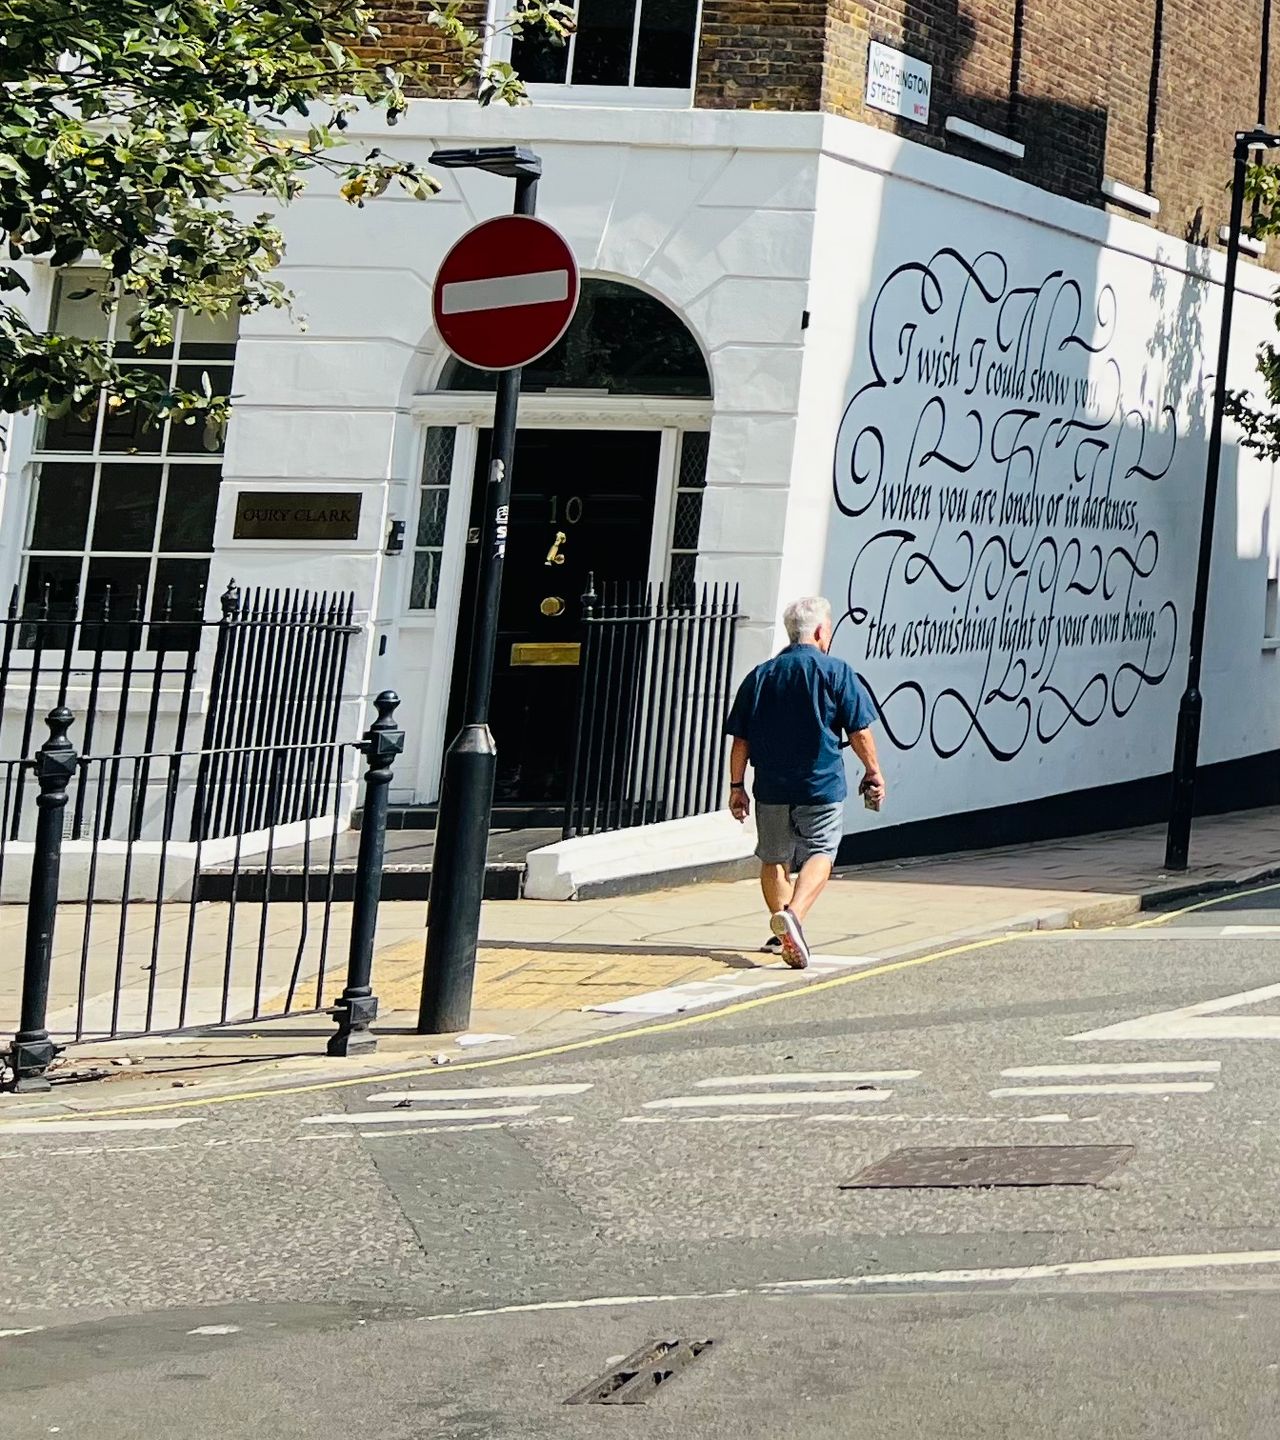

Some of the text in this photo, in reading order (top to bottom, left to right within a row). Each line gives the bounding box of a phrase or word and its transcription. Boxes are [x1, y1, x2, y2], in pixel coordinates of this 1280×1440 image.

[870, 81, 901, 107] STREET
[873, 60, 929, 96] NORTHINGTON
[893, 322, 917, 384] I
[964, 337, 987, 395] I
[243, 508, 353, 521] OURY CLARK
[550, 496, 583, 523] 10
[881, 482, 932, 522] when
[939, 485, 969, 523] you
[970, 487, 998, 526] are
[1046, 493, 1064, 527] or
[1064, 482, 1080, 528] in
[1080, 495, 1138, 538] darkness,
[865, 616, 896, 660] the
[900, 606, 997, 657] astonishing
[1056, 613, 1089, 647] your
[1090, 613, 1119, 646] own
